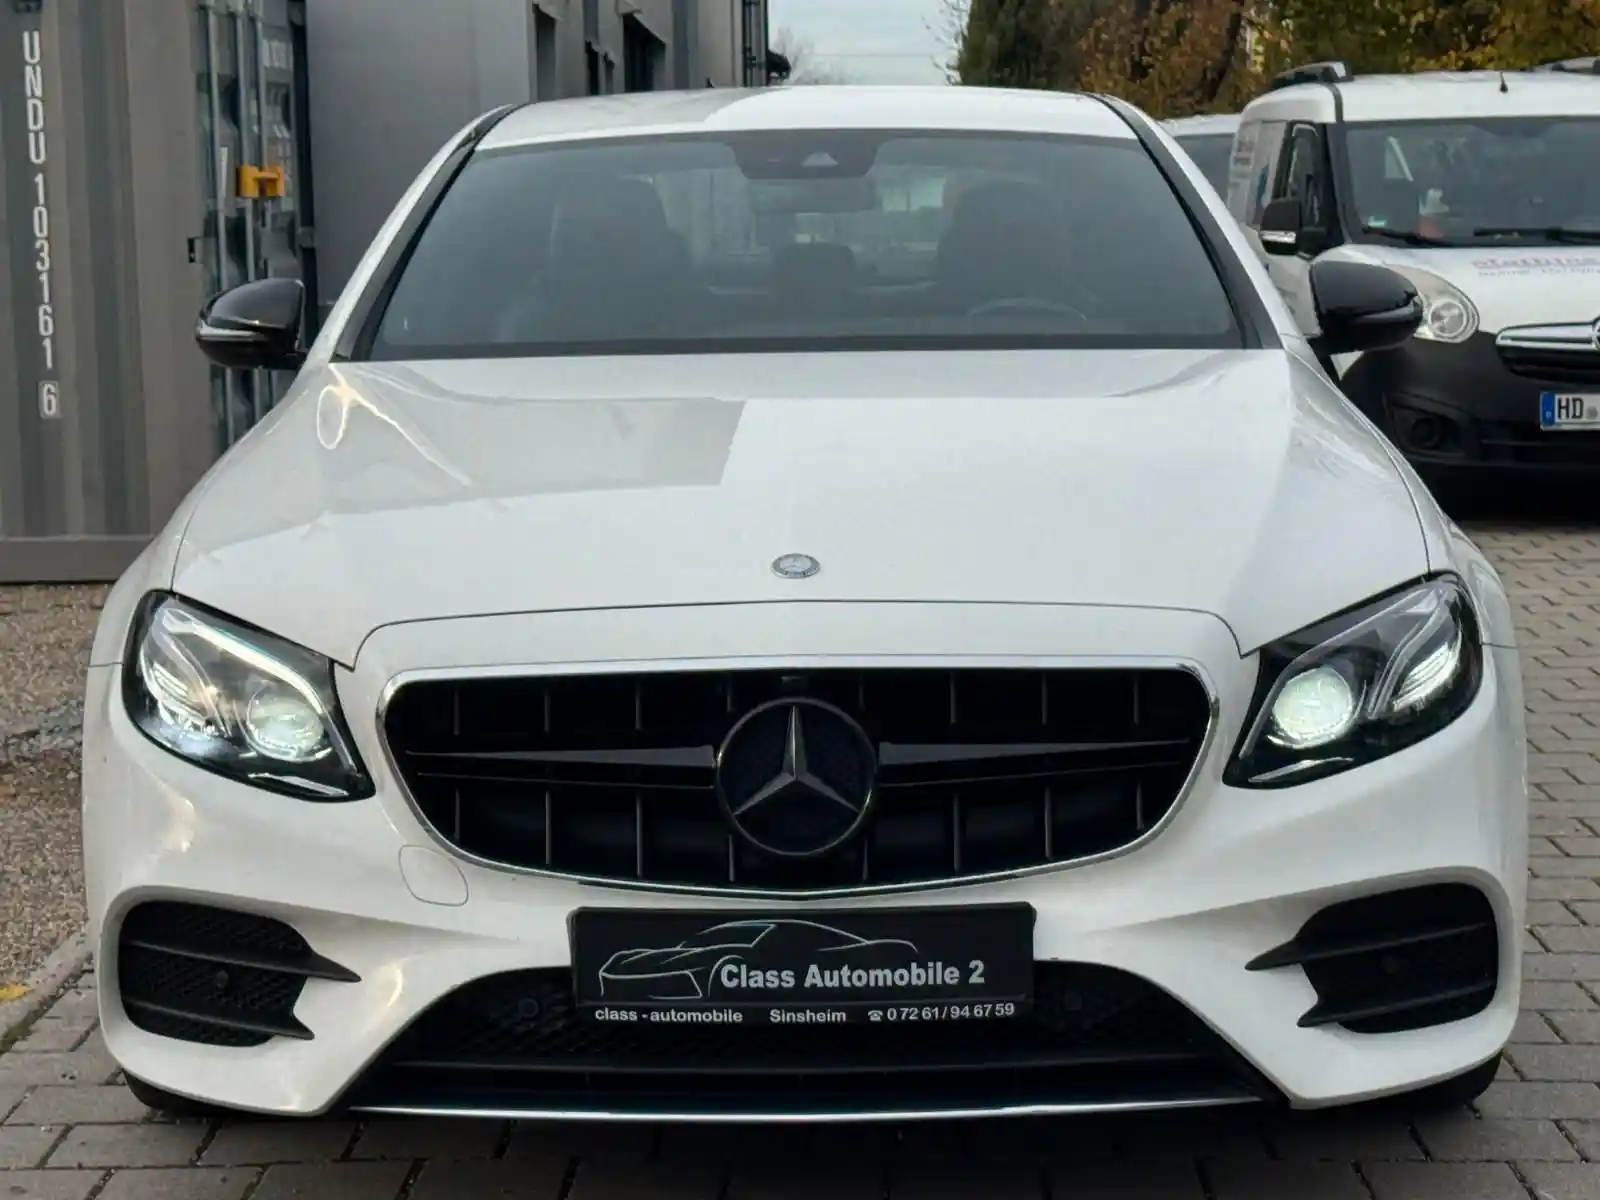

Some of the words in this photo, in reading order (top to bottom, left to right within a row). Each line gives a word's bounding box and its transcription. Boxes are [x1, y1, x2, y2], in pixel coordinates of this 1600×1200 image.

[1557, 397, 1584, 420] HD
[720, 964, 796, 989] Class
[804, 962, 960, 988] Automobile
[968, 960, 985, 984] 2
[769, 1009, 847, 1023] Sinsheim
